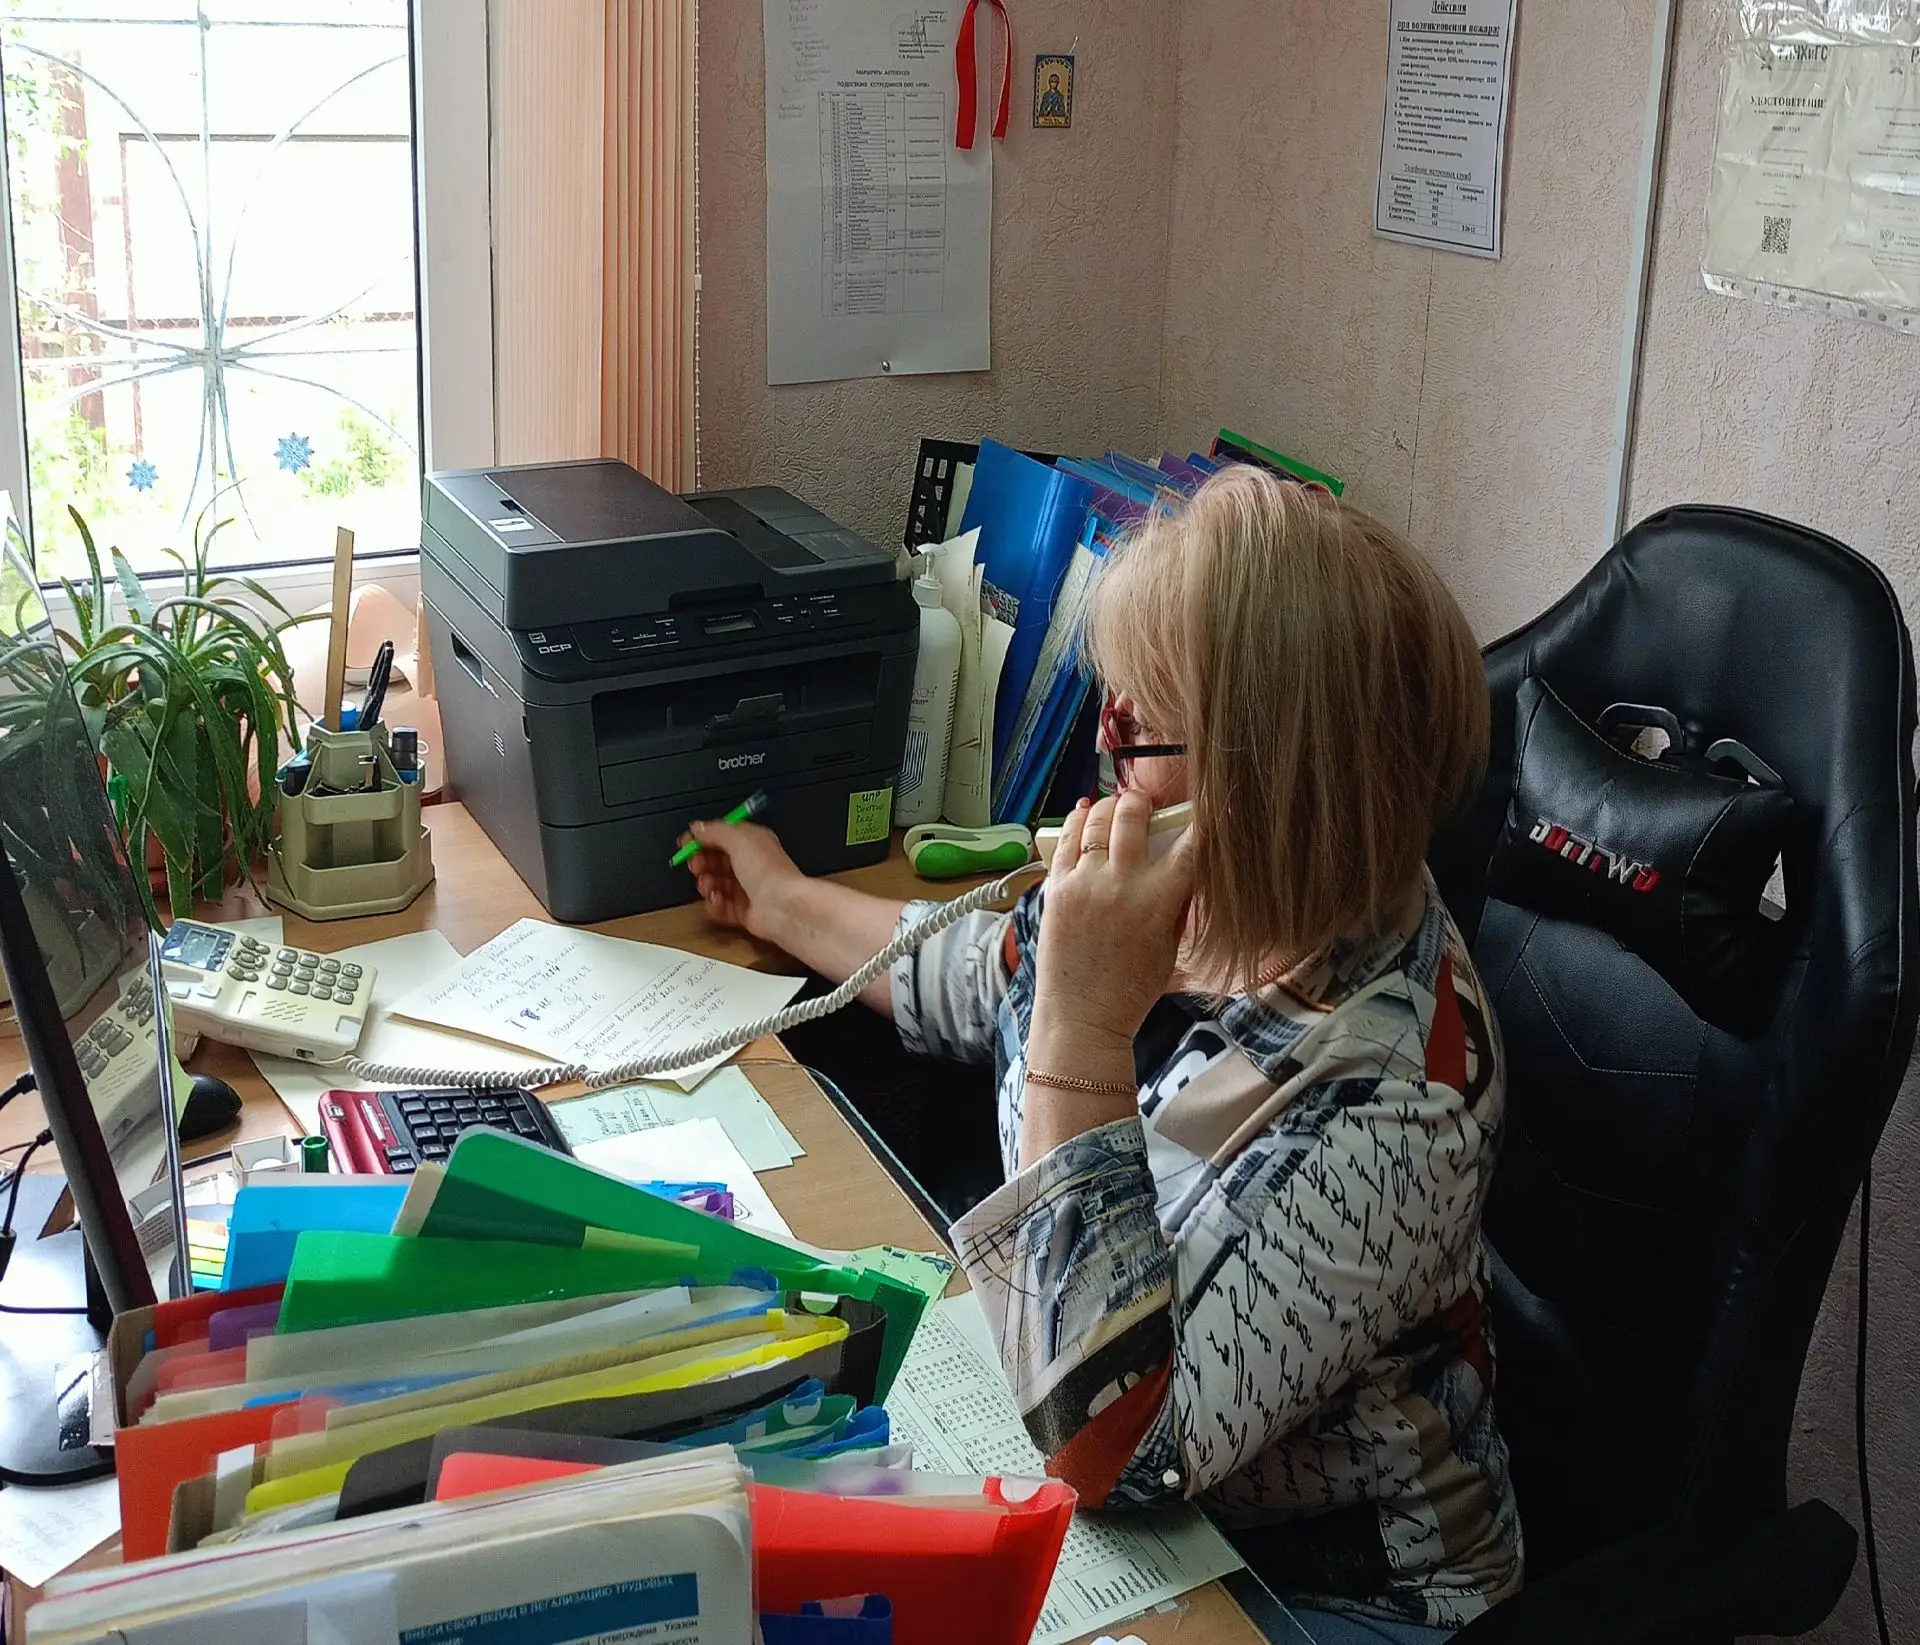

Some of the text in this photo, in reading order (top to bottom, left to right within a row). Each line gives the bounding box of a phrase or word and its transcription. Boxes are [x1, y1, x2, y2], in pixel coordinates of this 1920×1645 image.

[1431, 1, 1466, 14] Действия
[538, 642, 572, 655] DCP
[718, 752, 766, 771] brother
[405, 1624, 444, 1642] ВНЕСИ
[480, 1609, 518, 1626] ВКЛАД
[531, 1588, 613, 1614] ЛЕГАЛИЗАЦИЮ
[616, 1576, 675, 1595] ТРУДОВЫХ
